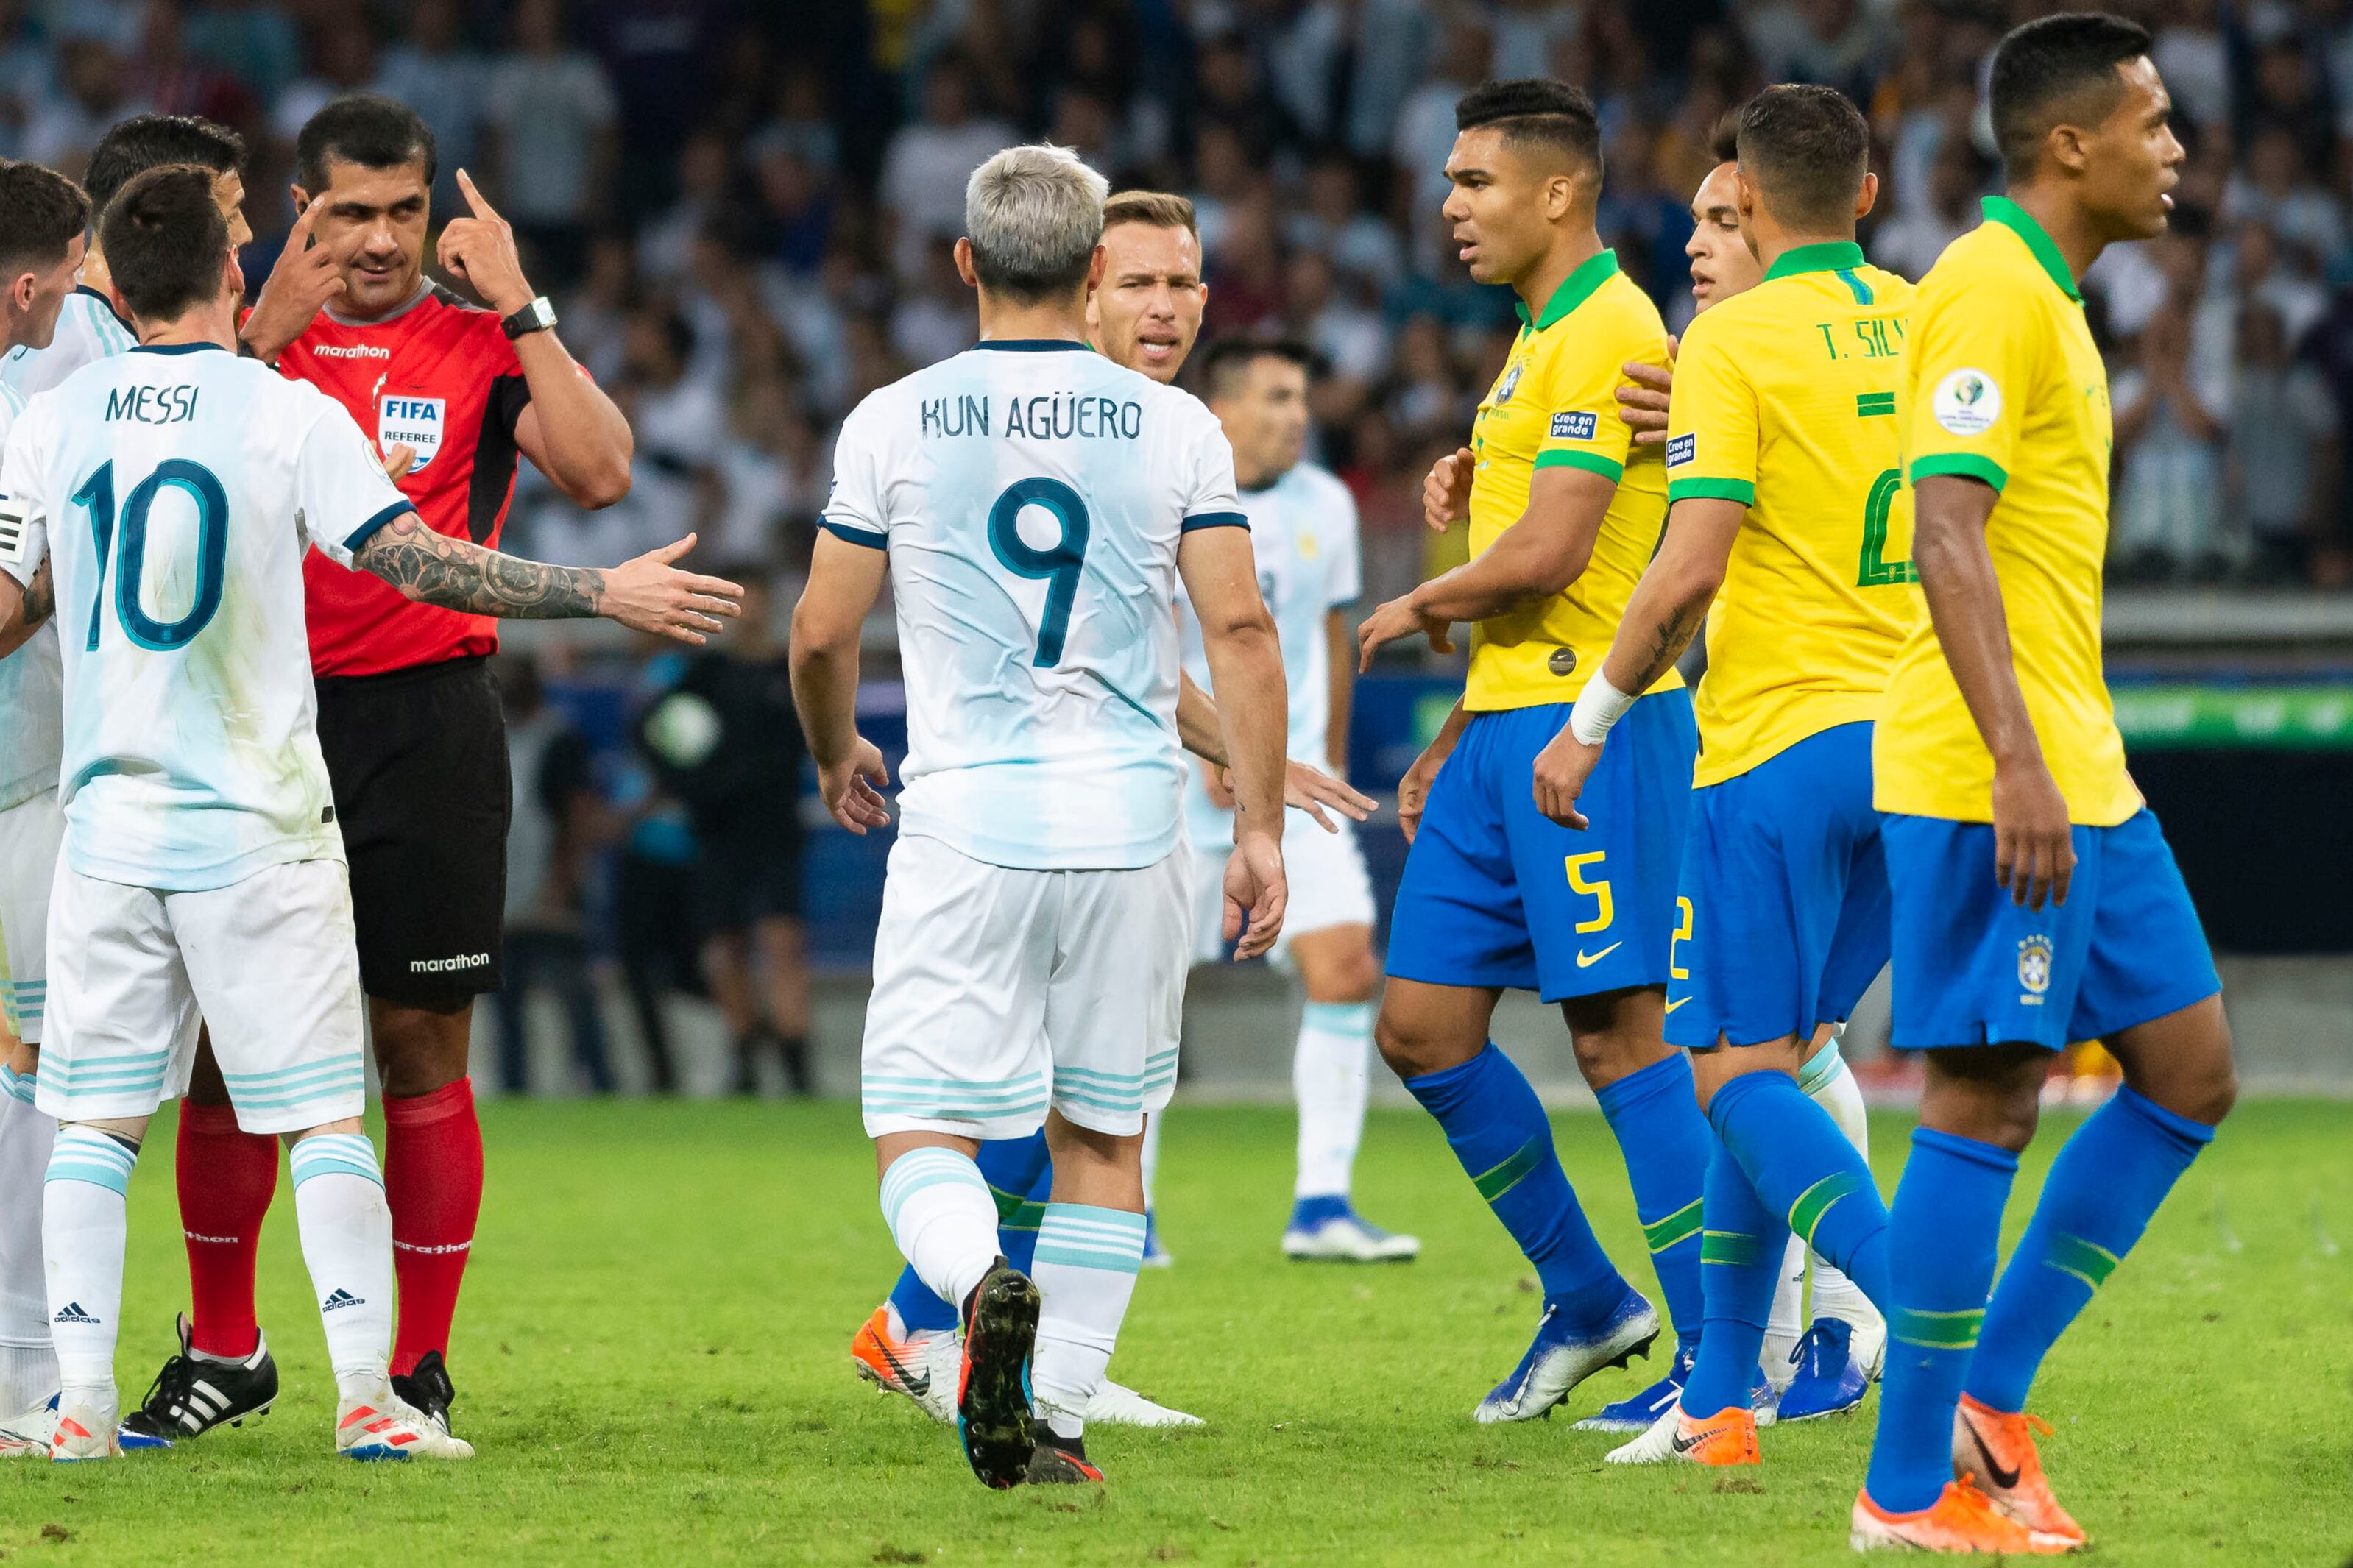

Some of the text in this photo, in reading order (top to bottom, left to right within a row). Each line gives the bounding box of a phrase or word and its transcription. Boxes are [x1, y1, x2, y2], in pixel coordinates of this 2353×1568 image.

[1855, 318, 1908, 358] SIL
[314, 344, 390, 360] marathon
[105, 384, 199, 425] MESSI
[386, 400, 437, 421] FIFA
[921, 391, 1142, 440] KUN AGÜERO
[1554, 413, 1592, 425] Cree en
[384, 430, 436, 444] REFEREE
[1552, 423, 1588, 436] grande
[1668, 438, 1693, 453] Cree en
[1668, 447, 1691, 467] grande
[71, 458, 229, 652] 10
[988, 476, 1090, 667] 9
[1565, 850, 1614, 934] 5
[1670, 895, 1694, 980] 2
[411, 952, 489, 973] marathon
[184, 1231, 238, 1244] thon
